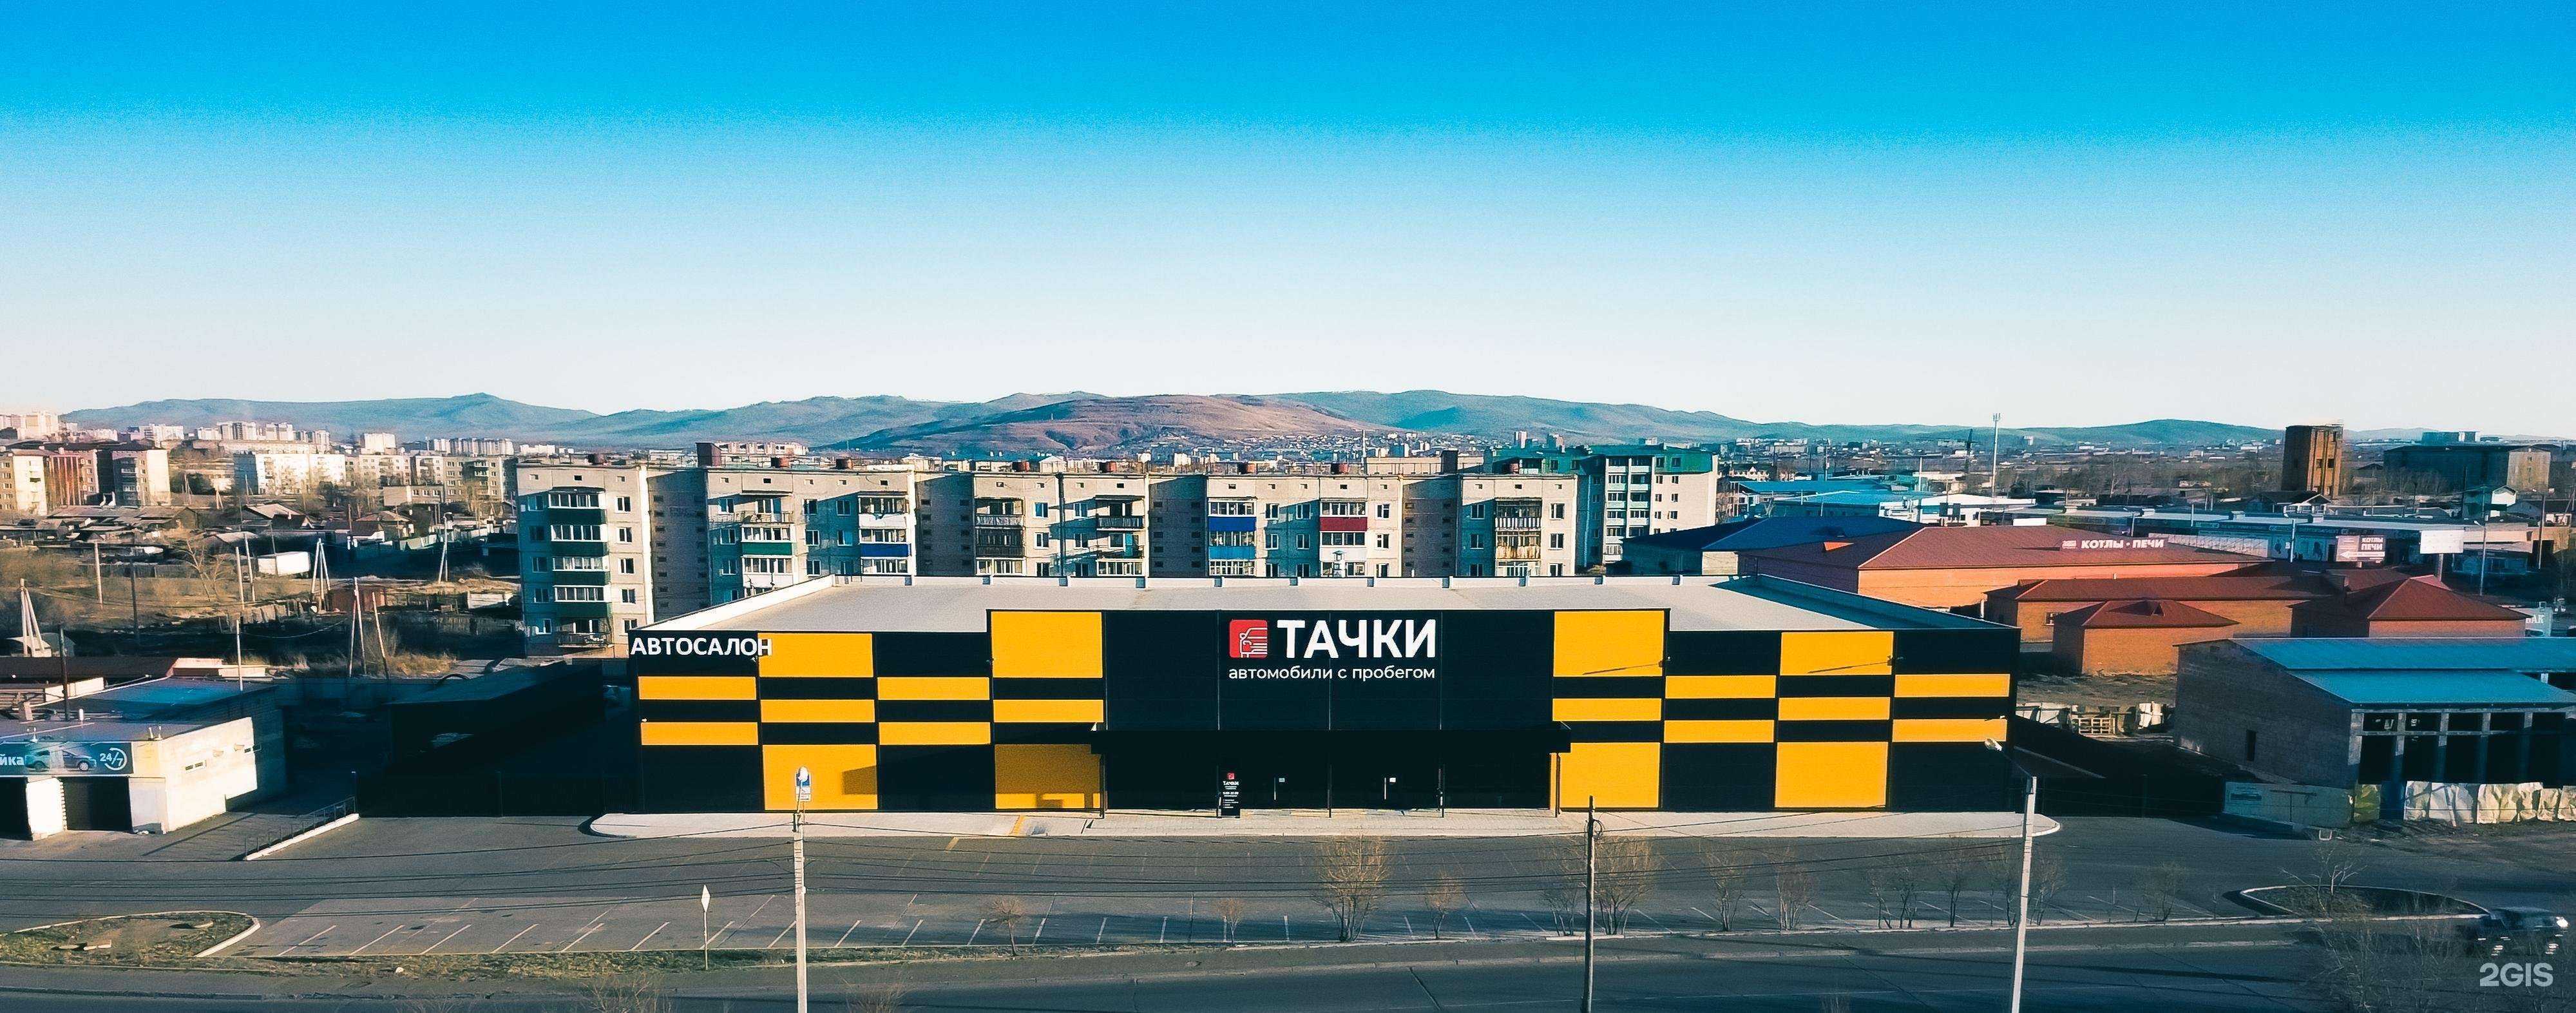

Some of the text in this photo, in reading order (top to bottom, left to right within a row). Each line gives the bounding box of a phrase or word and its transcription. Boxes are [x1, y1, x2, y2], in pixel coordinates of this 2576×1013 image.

[2081, 540, 2124, 549] КОТЛЫ
[2132, 539, 2164, 548] ПЕЧИ
[630, 637, 772, 657] АВТОСАЛОН
[1277, 619, 1436, 659] ТАЧКИ
[1228, 665, 1435, 682] автомобили с пробегом
[100, 753, 123, 766] 24/7
